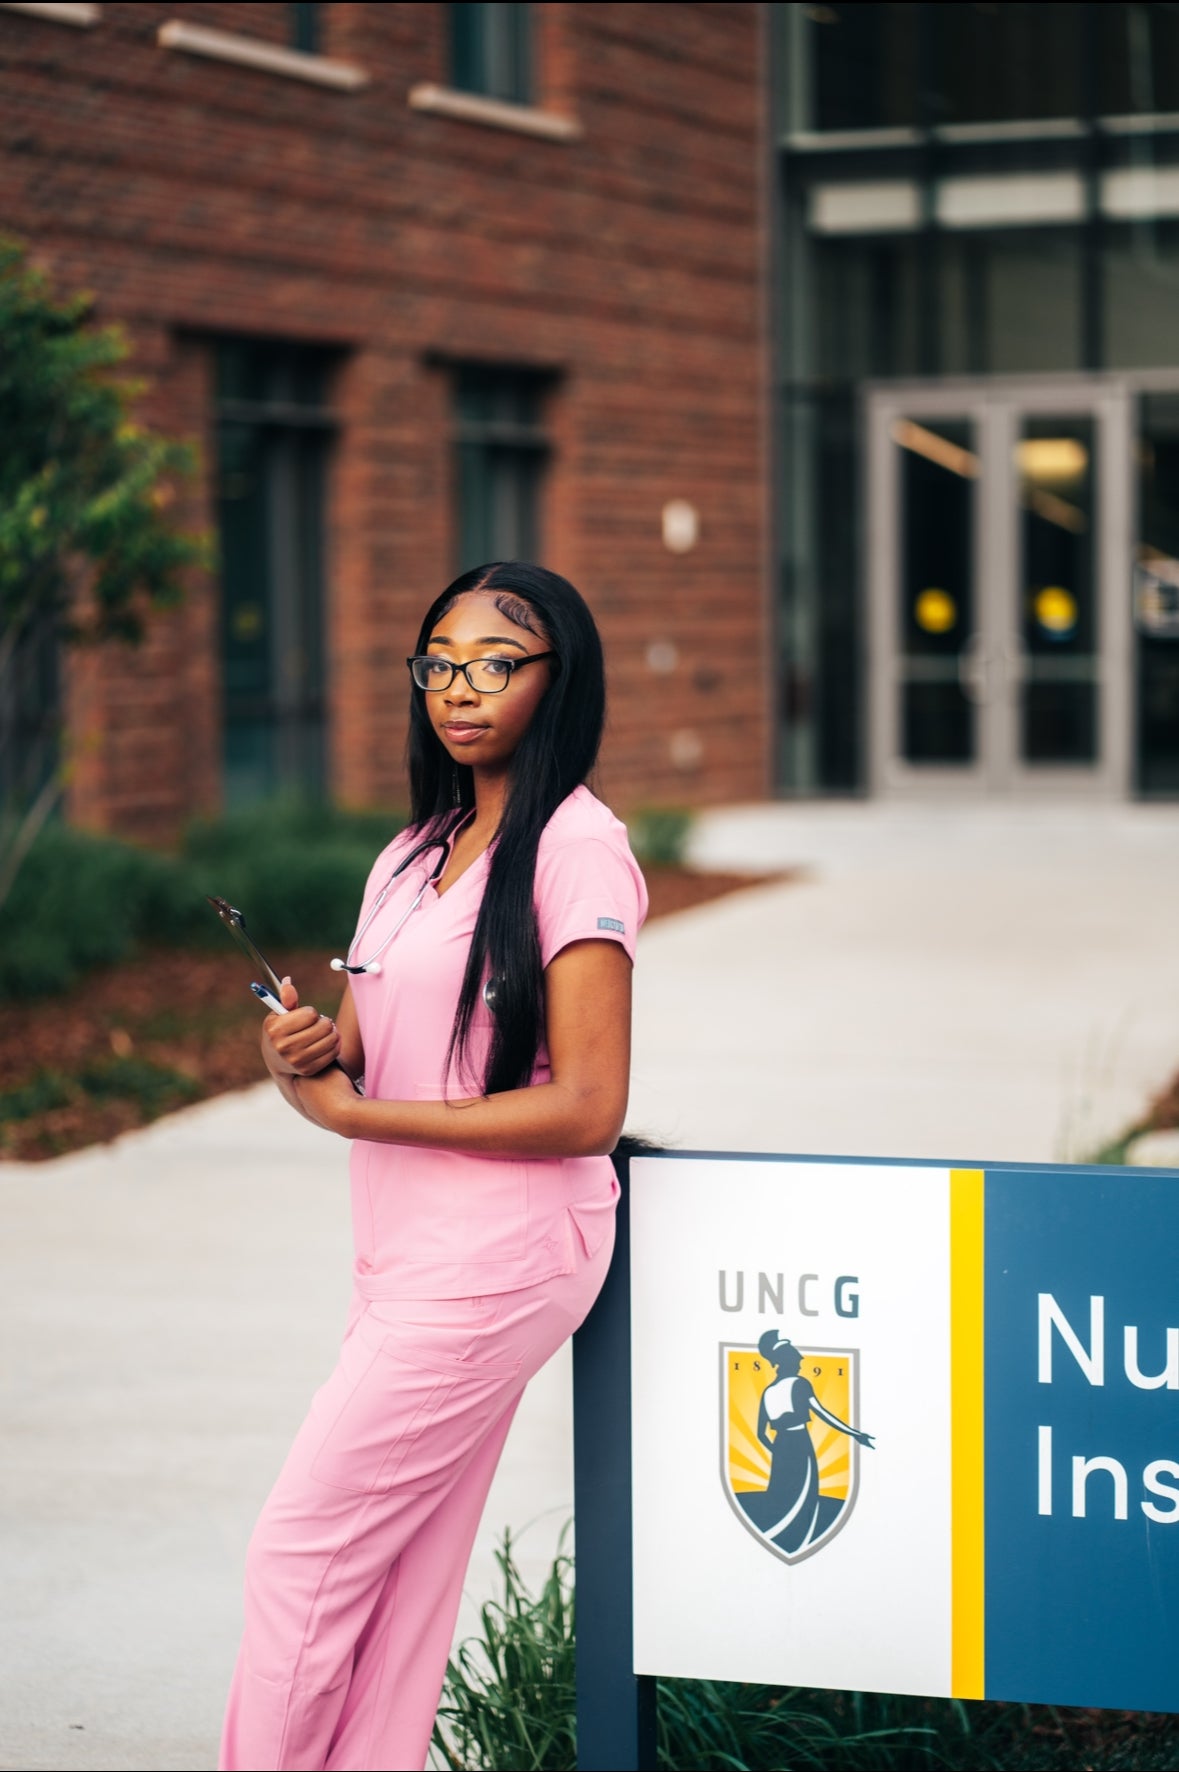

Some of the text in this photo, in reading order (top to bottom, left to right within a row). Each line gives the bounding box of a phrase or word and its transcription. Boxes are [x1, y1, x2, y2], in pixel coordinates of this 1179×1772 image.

[718, 1269, 860, 1319] UNCG
[1038, 1292, 1179, 1390] Nu
[1038, 1425, 1179, 1524] Ins
